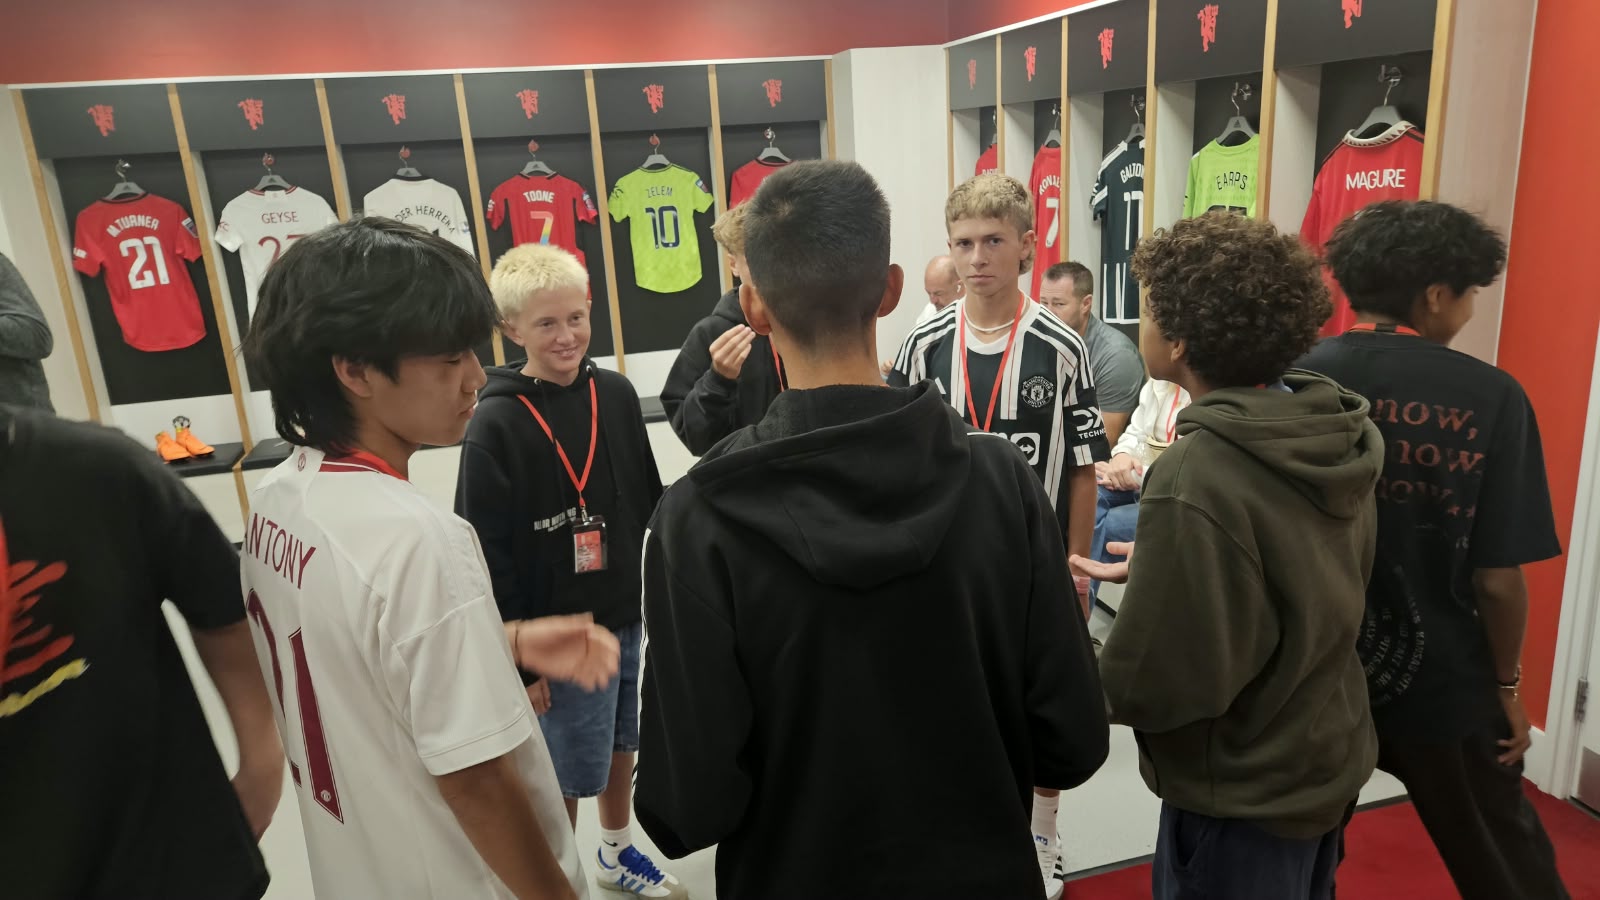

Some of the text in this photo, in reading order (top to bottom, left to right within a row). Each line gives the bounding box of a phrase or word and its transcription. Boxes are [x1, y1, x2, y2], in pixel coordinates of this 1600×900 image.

[1039, 174, 1061, 196] RONAL
[1216, 171, 1248, 190] EARPS
[1346, 168, 1406, 191] MAGURE
[523, 189, 555, 203] TOONE
[645, 185, 673, 198] ZELEM
[261, 211, 299, 224] GEYSE
[530, 210, 554, 246] 7
[645, 205, 680, 249] 10
[1045, 197, 1059, 248] 7
[119, 235, 170, 290] 21
